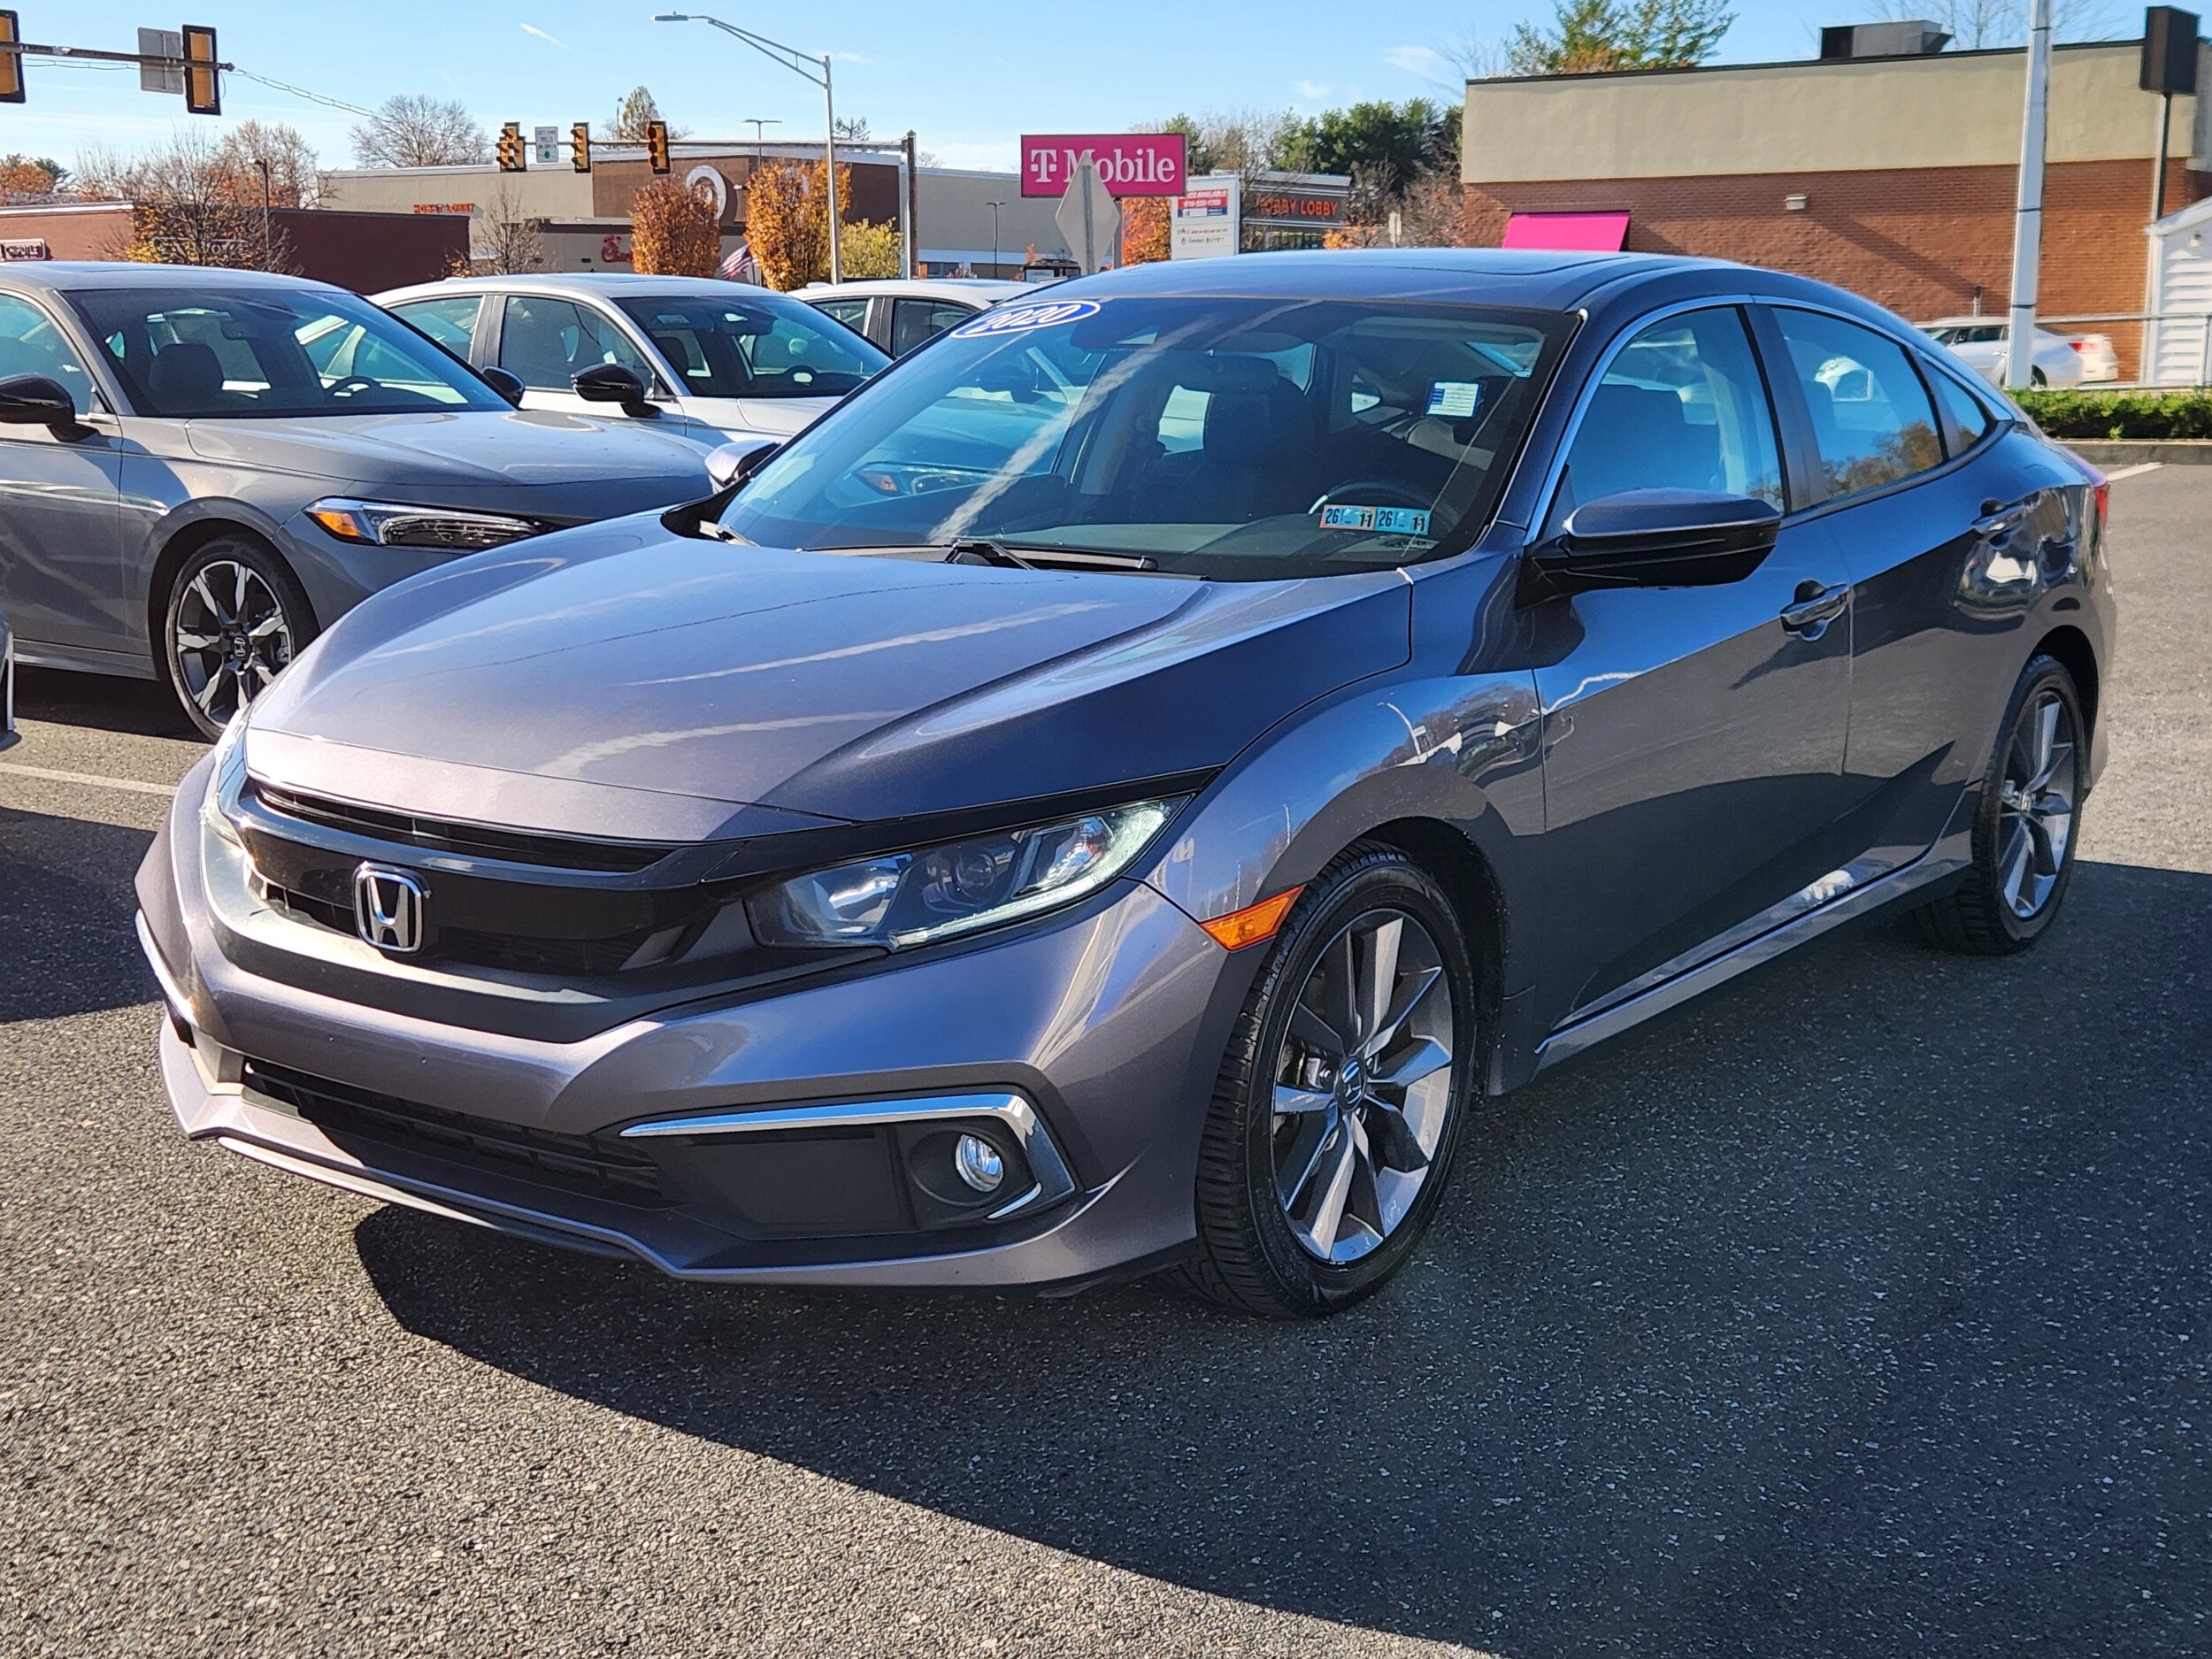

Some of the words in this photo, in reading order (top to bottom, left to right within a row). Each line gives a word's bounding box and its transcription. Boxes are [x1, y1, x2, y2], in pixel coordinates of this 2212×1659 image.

[1300, 200, 1338, 216] LOBBY
[964, 304, 1081, 335] 2020
[1325, 508, 1340, 525] 26
[1359, 513, 1372, 528] 11
[1379, 511, 1394, 527] 26
[1412, 516, 1425, 532] 11
